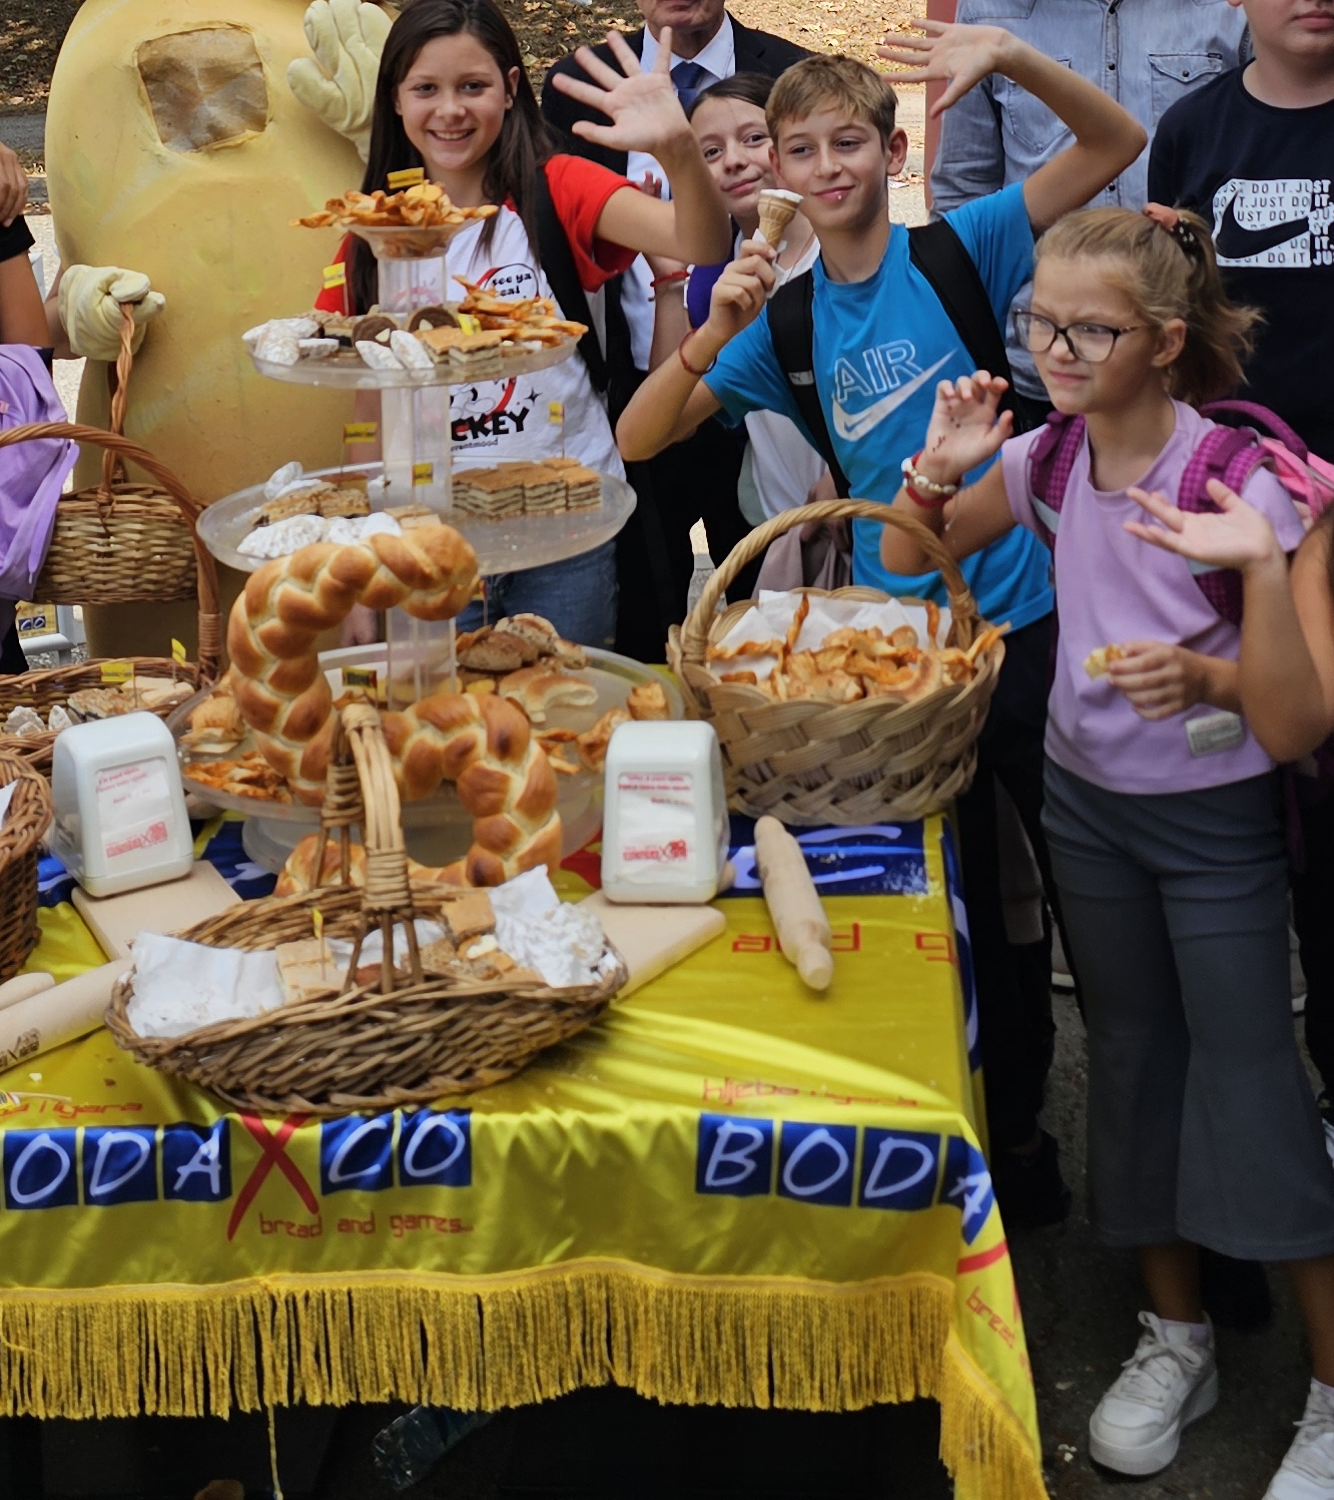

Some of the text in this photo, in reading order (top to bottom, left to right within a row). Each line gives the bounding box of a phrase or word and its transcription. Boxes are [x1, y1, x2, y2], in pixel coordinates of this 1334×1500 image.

[1252, 183, 1269, 194] DO
[1239, 196, 1285, 208] T.JUST
[1291, 196, 1310, 207] DO
[1237, 210, 1262, 222] UST
[1269, 210, 1286, 221] DO
[1268, 252, 1286, 263] DO
[498, 285, 520, 297] eal
[833, 338, 925, 405] AIR
[451, 405, 530, 442] CKEY
[259, 1211, 323, 1240] bread
[336, 1211, 377, 1235] and
